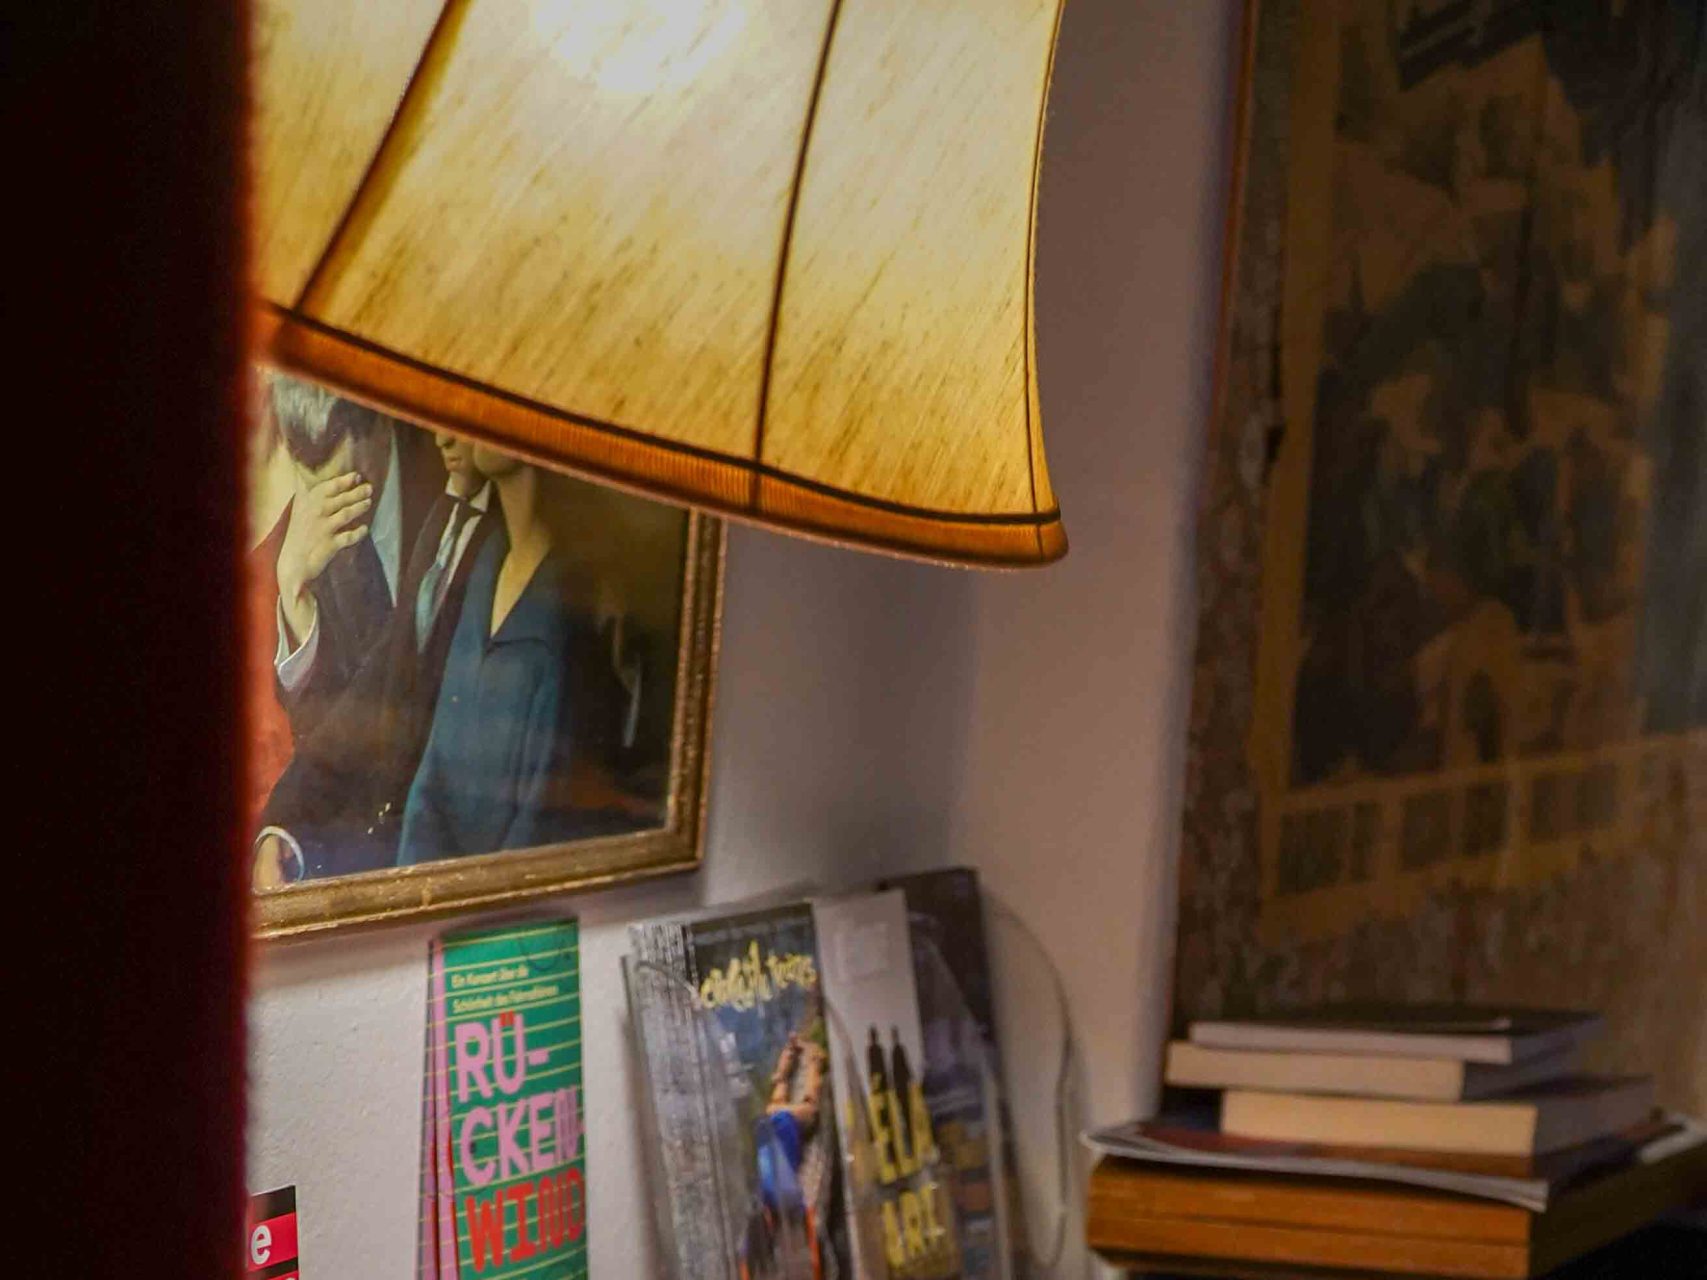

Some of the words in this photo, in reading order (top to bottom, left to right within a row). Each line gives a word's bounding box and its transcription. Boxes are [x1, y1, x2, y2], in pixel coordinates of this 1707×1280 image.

[455, 1010, 549, 1103] RÜ-
[460, 1084, 585, 1187] CKEN
[251, 1224, 272, 1265] e
[466, 1167, 584, 1273] WIND
